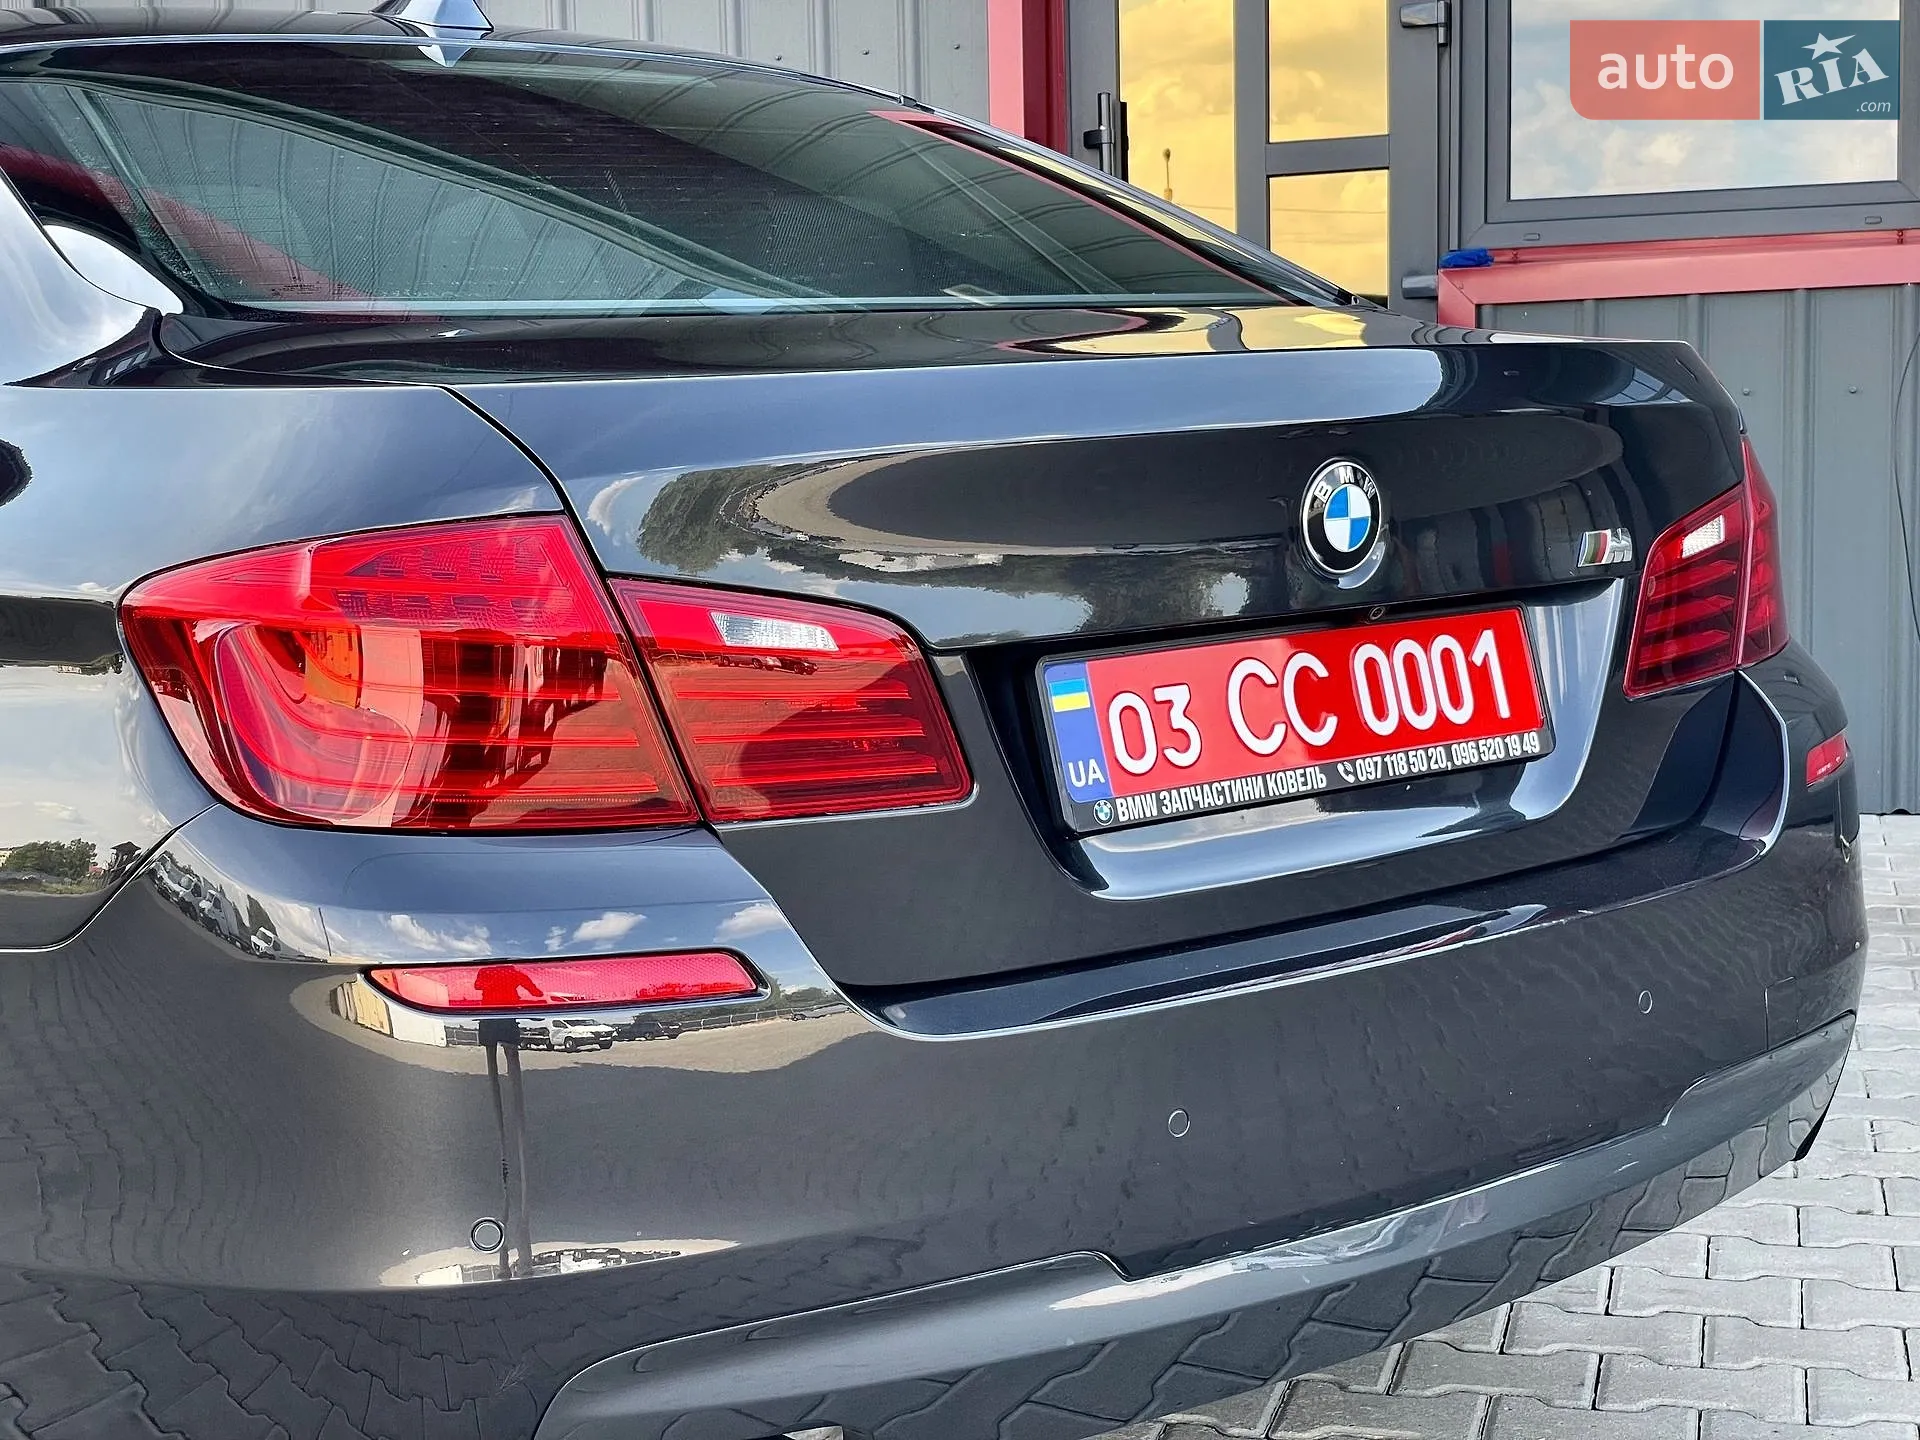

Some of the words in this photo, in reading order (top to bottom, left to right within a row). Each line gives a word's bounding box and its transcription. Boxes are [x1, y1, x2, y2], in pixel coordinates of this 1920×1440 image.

[1314, 465, 1375, 503] BMW
[1108, 683, 1202, 775] 03
[1228, 652, 1338, 755] CC
[1353, 629, 1510, 737] 0001
[1070, 756, 1105, 788] UA
[1356, 755, 1383, 781] 097
[1384, 752, 1408, 777] 118
[1409, 750, 1428, 773] 50
[1428, 746, 1452, 771] 20,
[1451, 741, 1479, 766] 096
[1479, 736, 1505, 761] 520
[1505, 733, 1521, 757] 19
[1522, 731, 1540, 754] 49
[1115, 793, 1158, 822] BMW
[1161, 779, 1265, 814] ЗАПЧАСТИНИ
[1266, 766, 1327, 797] КОВЕЛЬ
